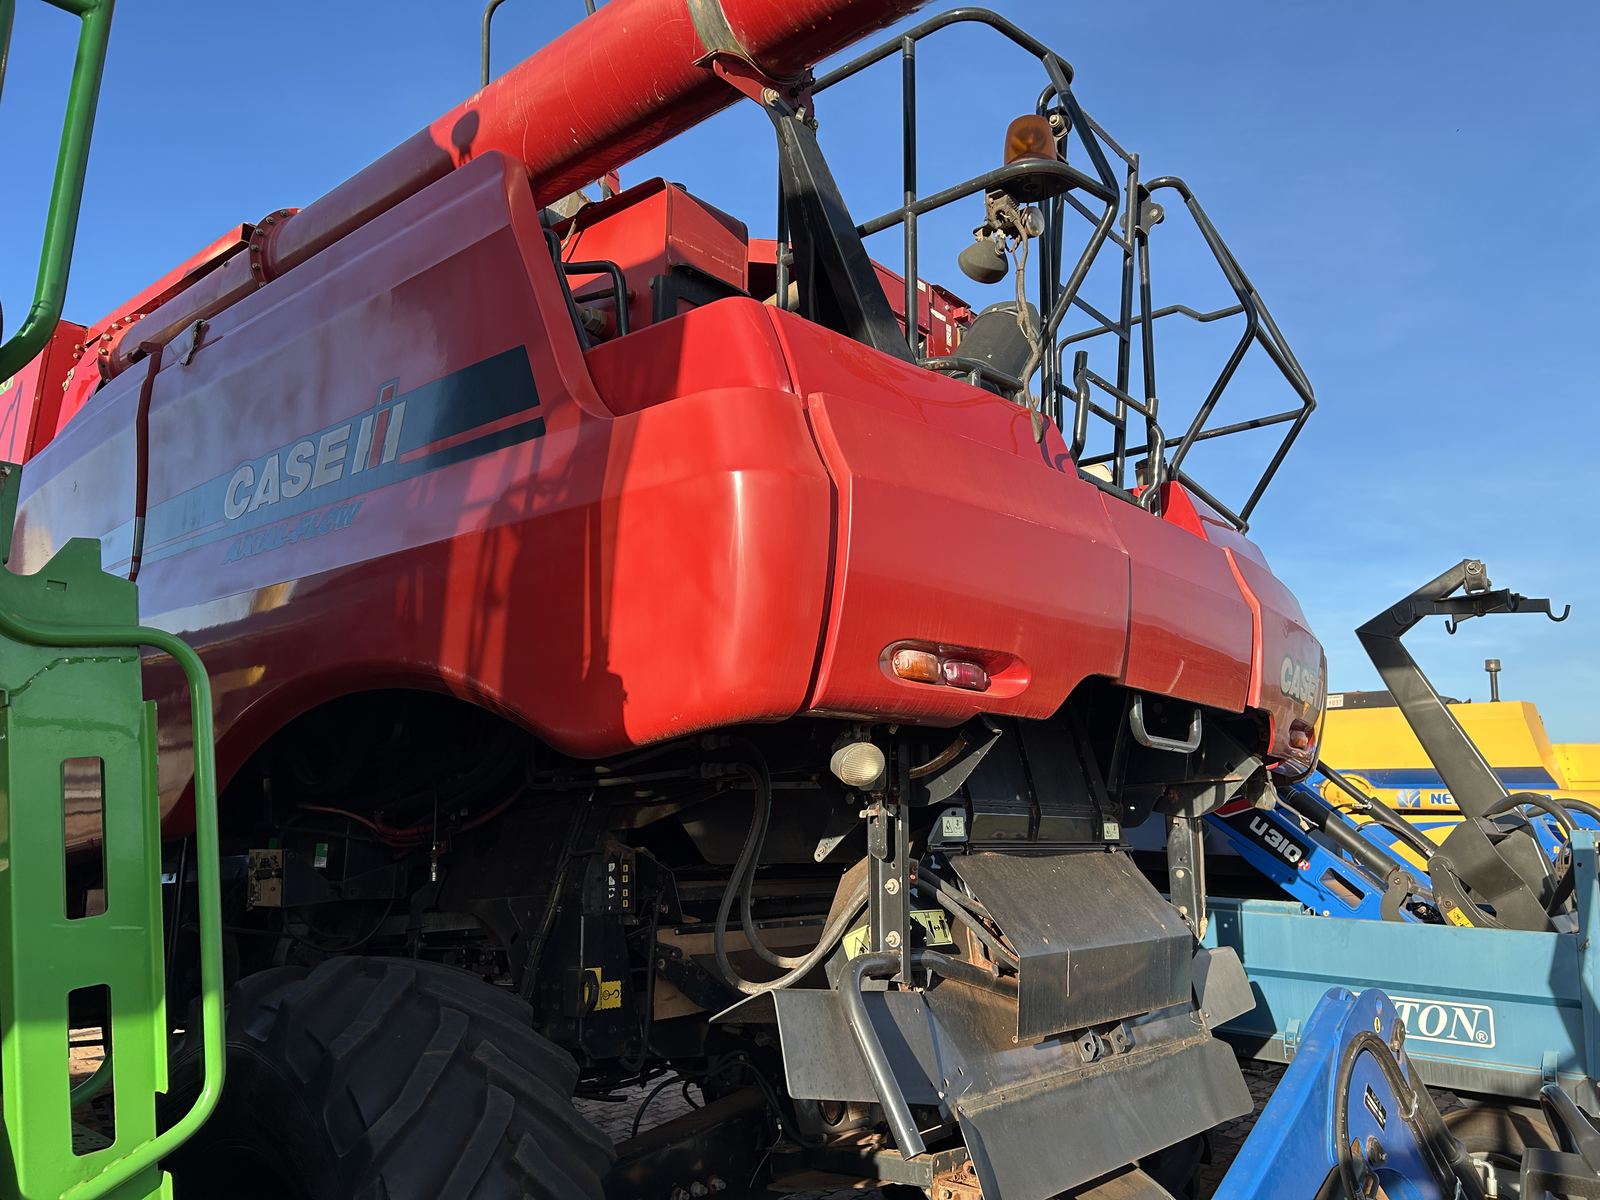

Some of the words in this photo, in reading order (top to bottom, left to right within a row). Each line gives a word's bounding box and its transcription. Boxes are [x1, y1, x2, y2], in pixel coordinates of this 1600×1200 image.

[224, 424, 352, 519] CASE
[1430, 793, 1453, 805] NE
[1250, 816, 1302, 862] U310
